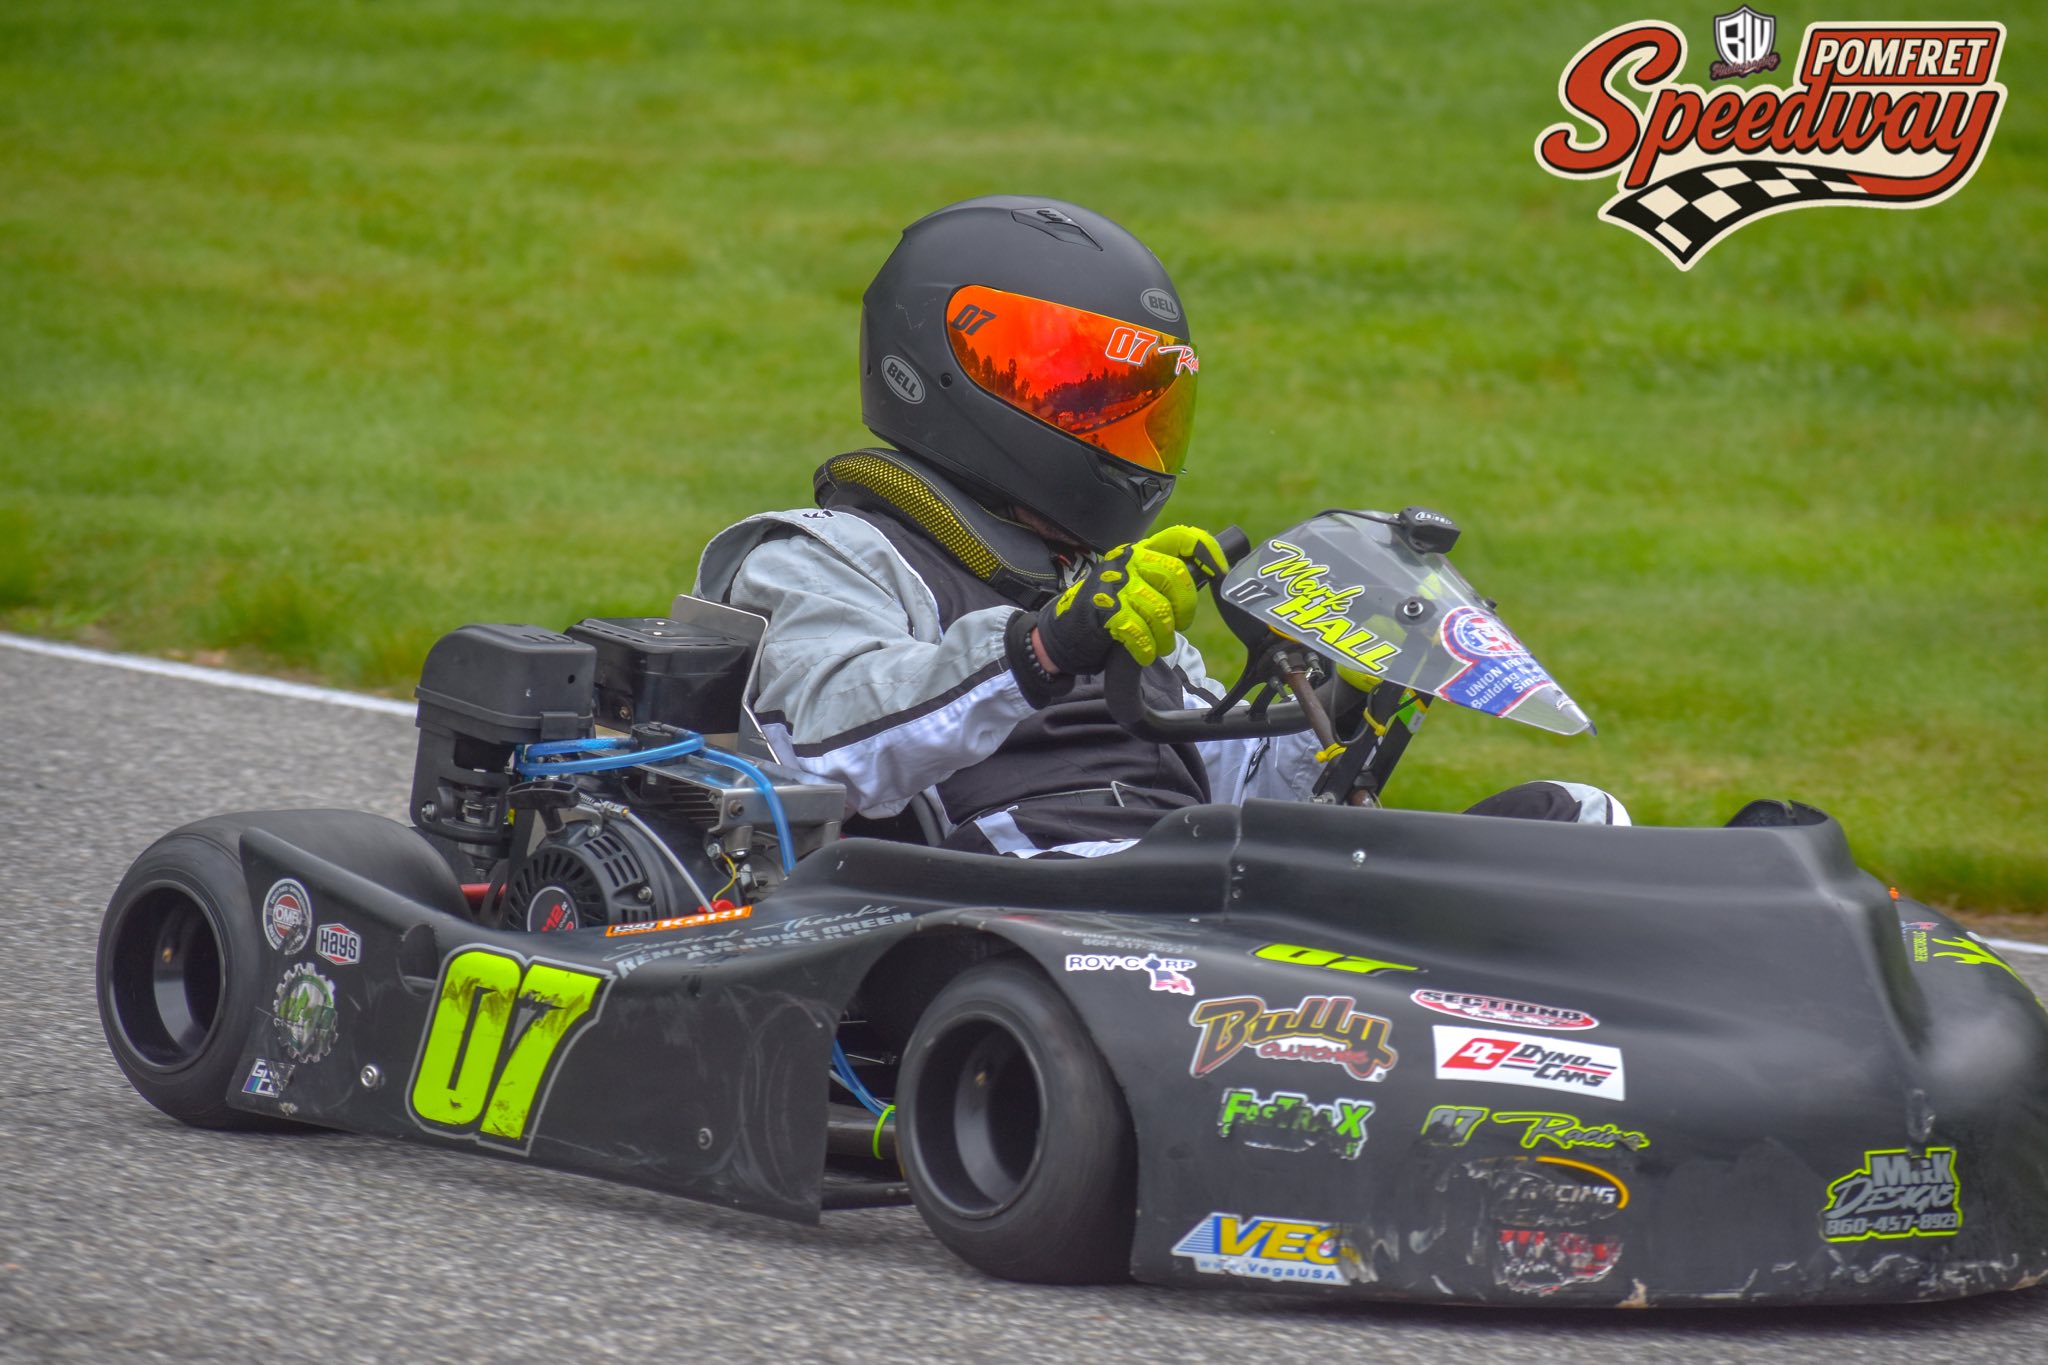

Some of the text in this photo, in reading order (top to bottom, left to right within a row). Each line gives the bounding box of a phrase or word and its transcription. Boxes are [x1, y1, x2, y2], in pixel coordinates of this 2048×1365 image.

[952, 304, 997, 336] 07
[1148, 295, 1177, 316] BELL
[1105, 326, 1159, 367] 07
[885, 360, 918, 398] BELL
[1258, 540, 1364, 614] Mark
[1267, 594, 1401, 674] HALL
[1466, 666, 1503, 697] UNION
[1470, 672, 1519, 709] Building
[743, 930, 816, 945] MIKE
[822, 912, 913, 934] GREEN
[752, 905, 899, 931] Thanks
[320, 929, 358, 960] Hays
[1253, 943, 1419, 974] 07
[1068, 956, 1116, 969] ROY
[410, 949, 604, 1142] 07
[1191, 996, 1398, 1079] Bully
[1459, 1042, 1506, 1065] DC
[1511, 1043, 1591, 1066] DYNO
[1533, 1062, 1610, 1088] CAMS
[1421, 1105, 1650, 1150] 07 Racing
[1825, 1176, 1955, 1219] DESIGNS
